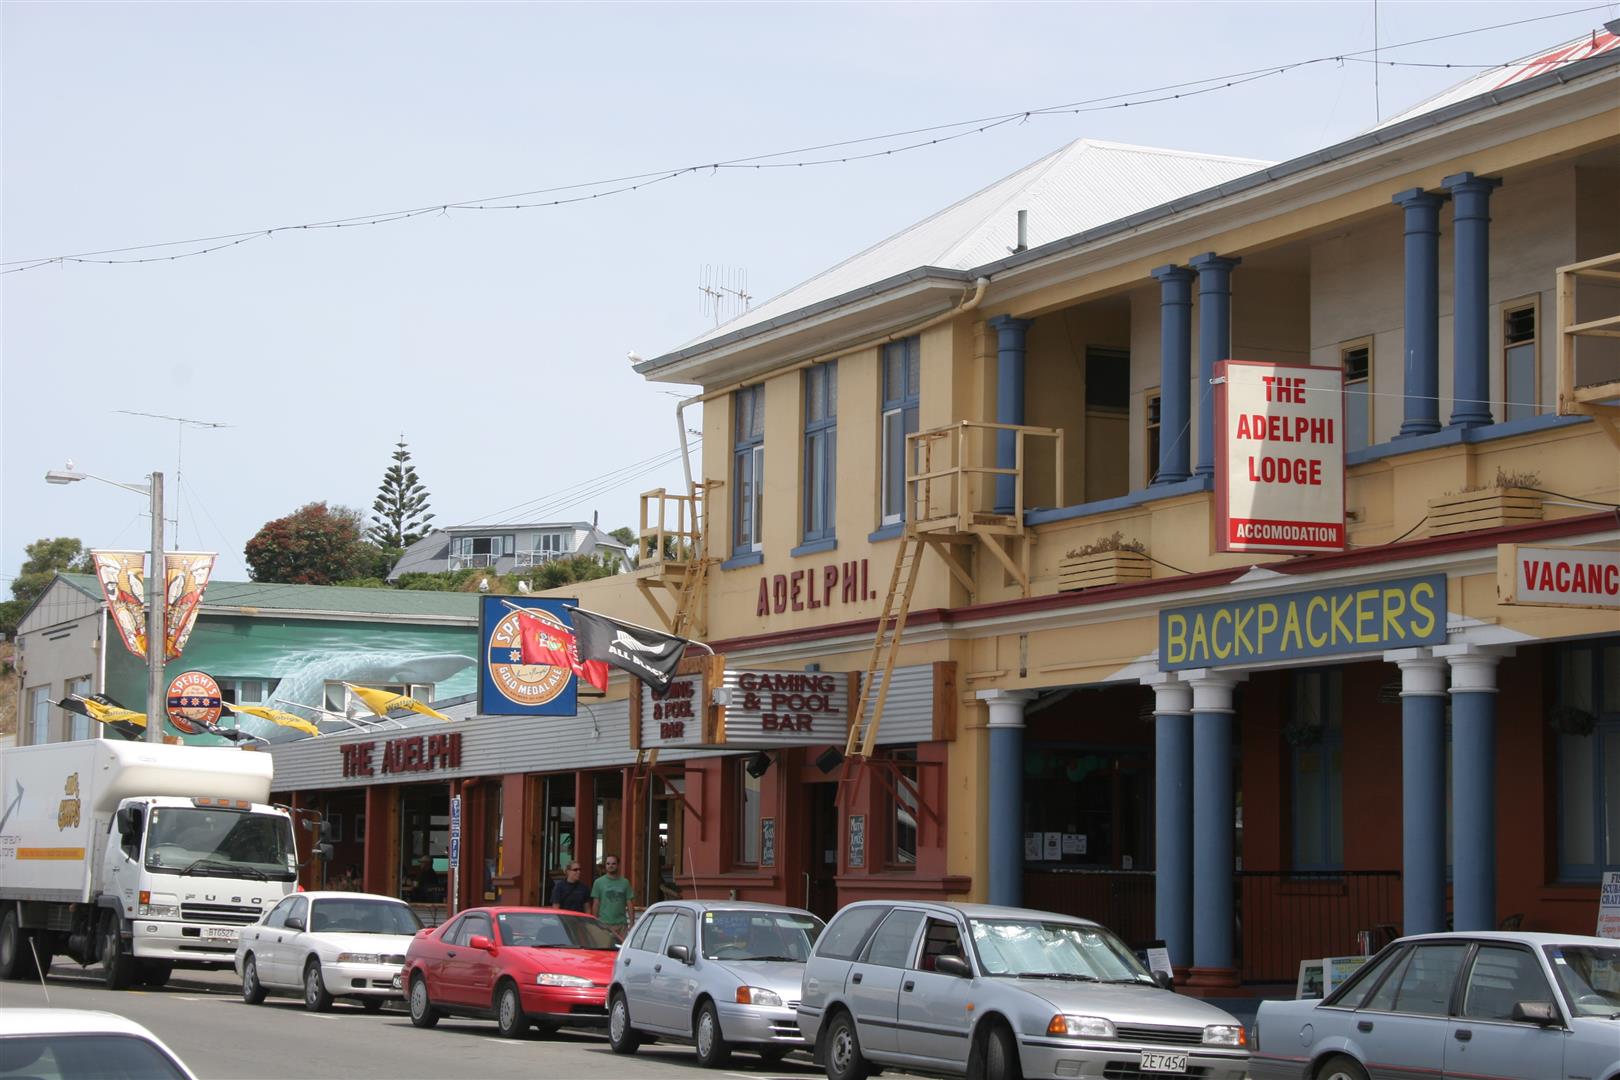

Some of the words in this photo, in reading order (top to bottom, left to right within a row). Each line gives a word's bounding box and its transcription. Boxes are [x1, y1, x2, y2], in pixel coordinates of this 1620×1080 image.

[1262, 376, 1306, 404] THE
[1236, 414, 1334, 444] ADELPHI
[1248, 456, 1322, 485] LODGE
[1236, 523, 1337, 542] ACCOMODATION
[1168, 582, 1435, 664] BACKPACKERS
[608, 645, 631, 660] ALL
[499, 666, 518, 690] GOLD
[517, 682, 550, 696] MEDAL
[549, 669, 562, 687] ALE
[739, 673, 836, 693] GAMING
[743, 692, 760, 711] &
[771, 694, 839, 713] POOL
[660, 721, 685, 740] BAR
[762, 714, 813, 731] BAR
[340, 742, 376, 777] THE
[381, 732, 462, 773] ADELPHI
[185, 894, 262, 904] FUSO
[1142, 1054, 1186, 1071] ZE7454
